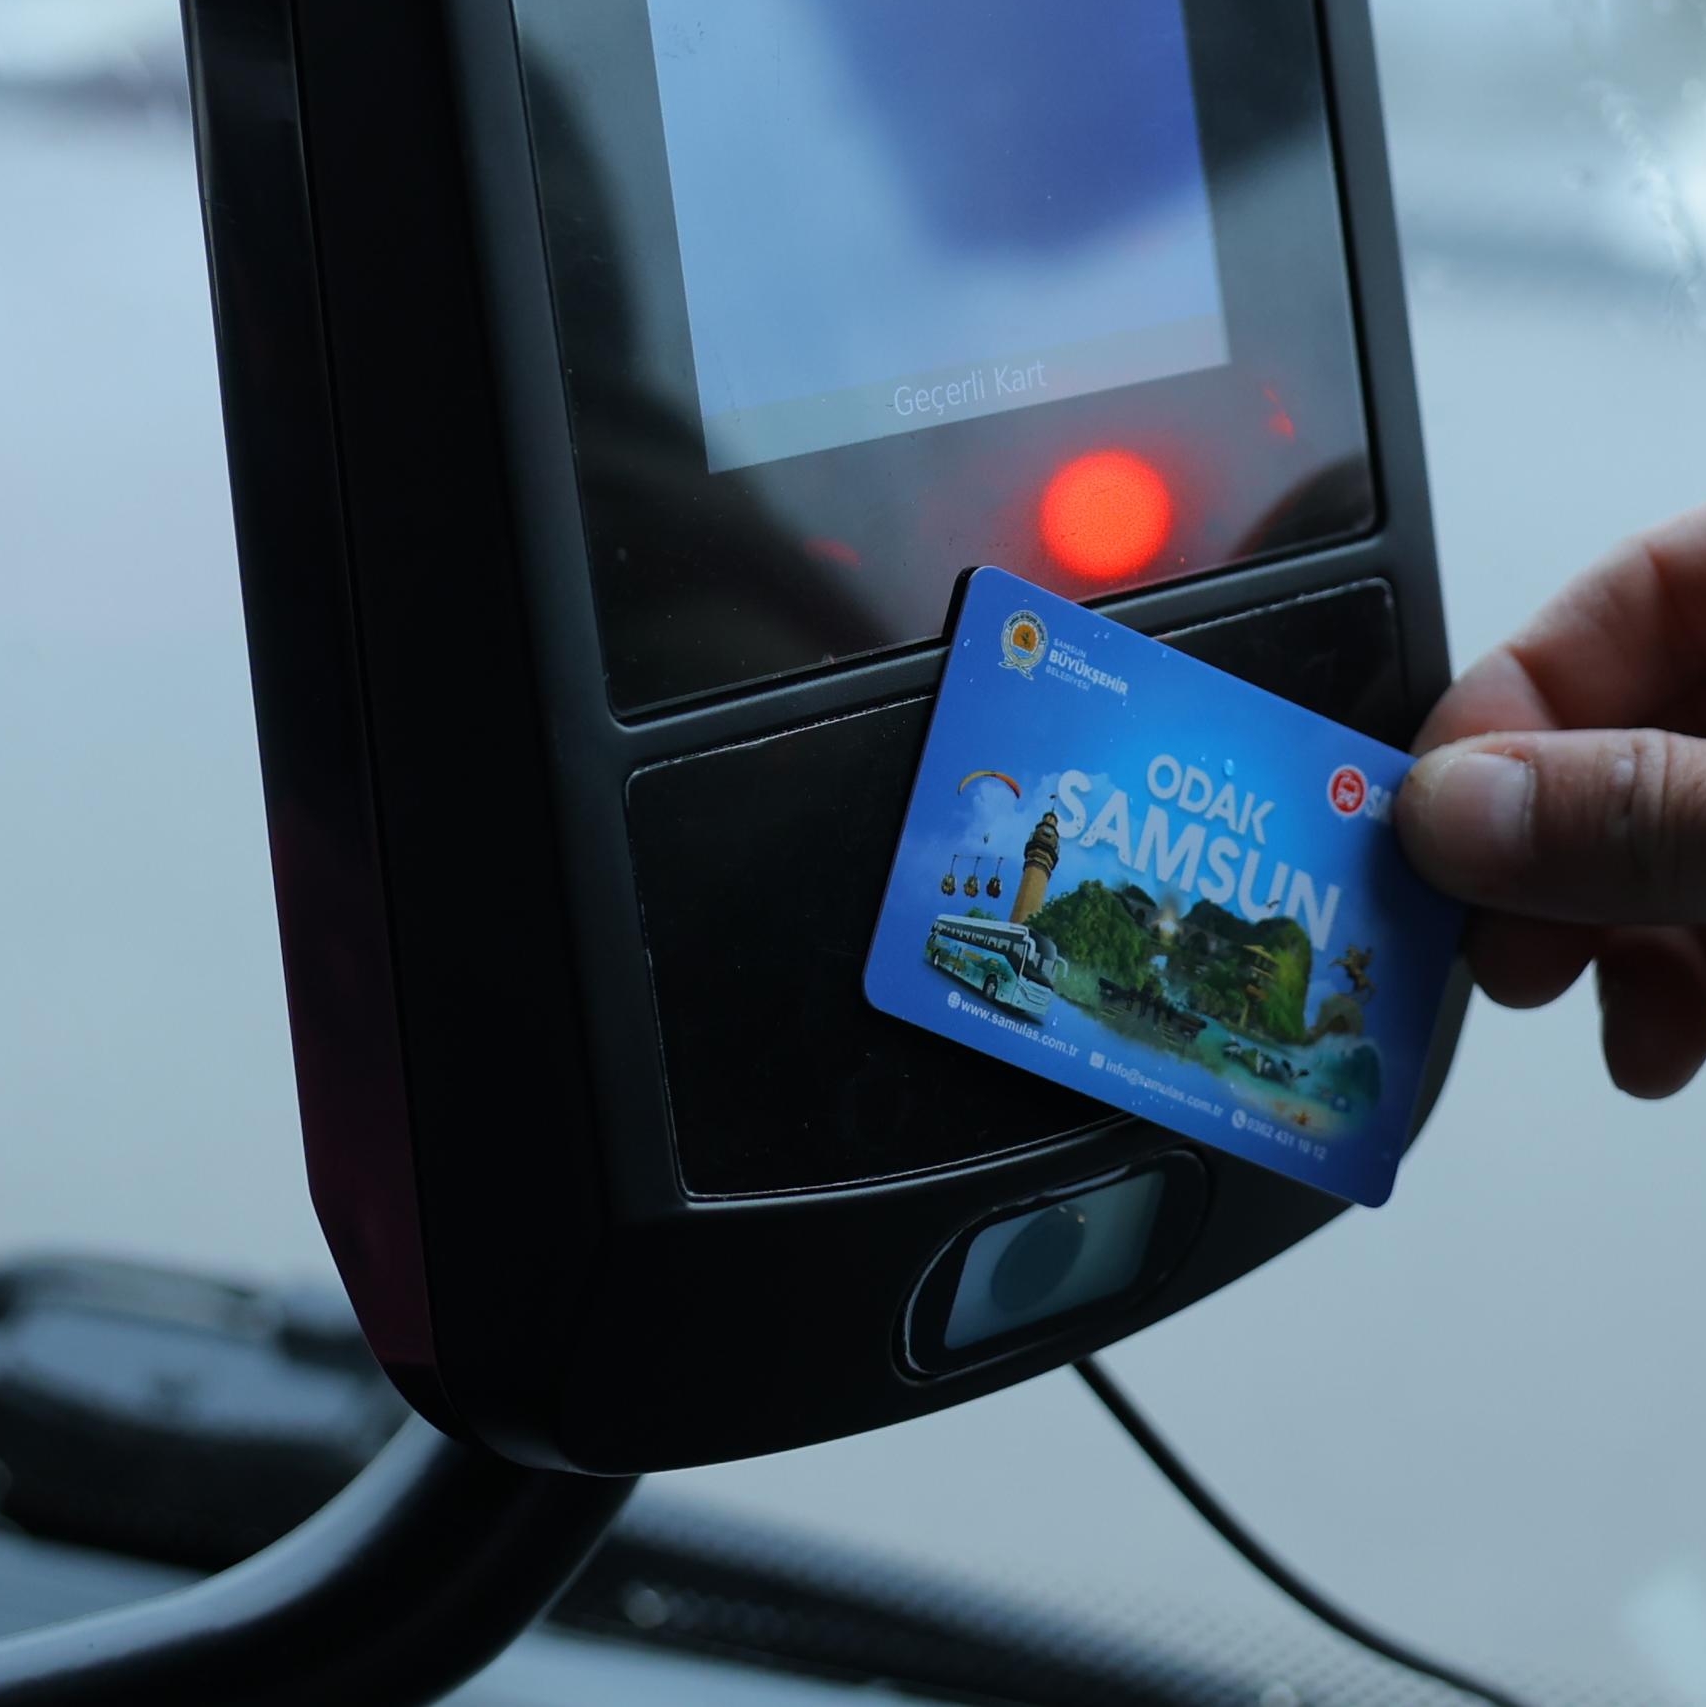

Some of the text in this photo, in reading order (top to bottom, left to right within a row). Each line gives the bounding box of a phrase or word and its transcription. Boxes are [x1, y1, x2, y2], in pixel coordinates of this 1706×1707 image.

[894, 359, 1047, 416] Geçerli Kart
[1048, 648, 1129, 697] BÜYÜKŞEHİR
[1147, 754, 1276, 845] ODAK
[1054, 769, 1340, 951] SAMSUN
[960, 998, 1080, 1058] www.samulas.com.tr
